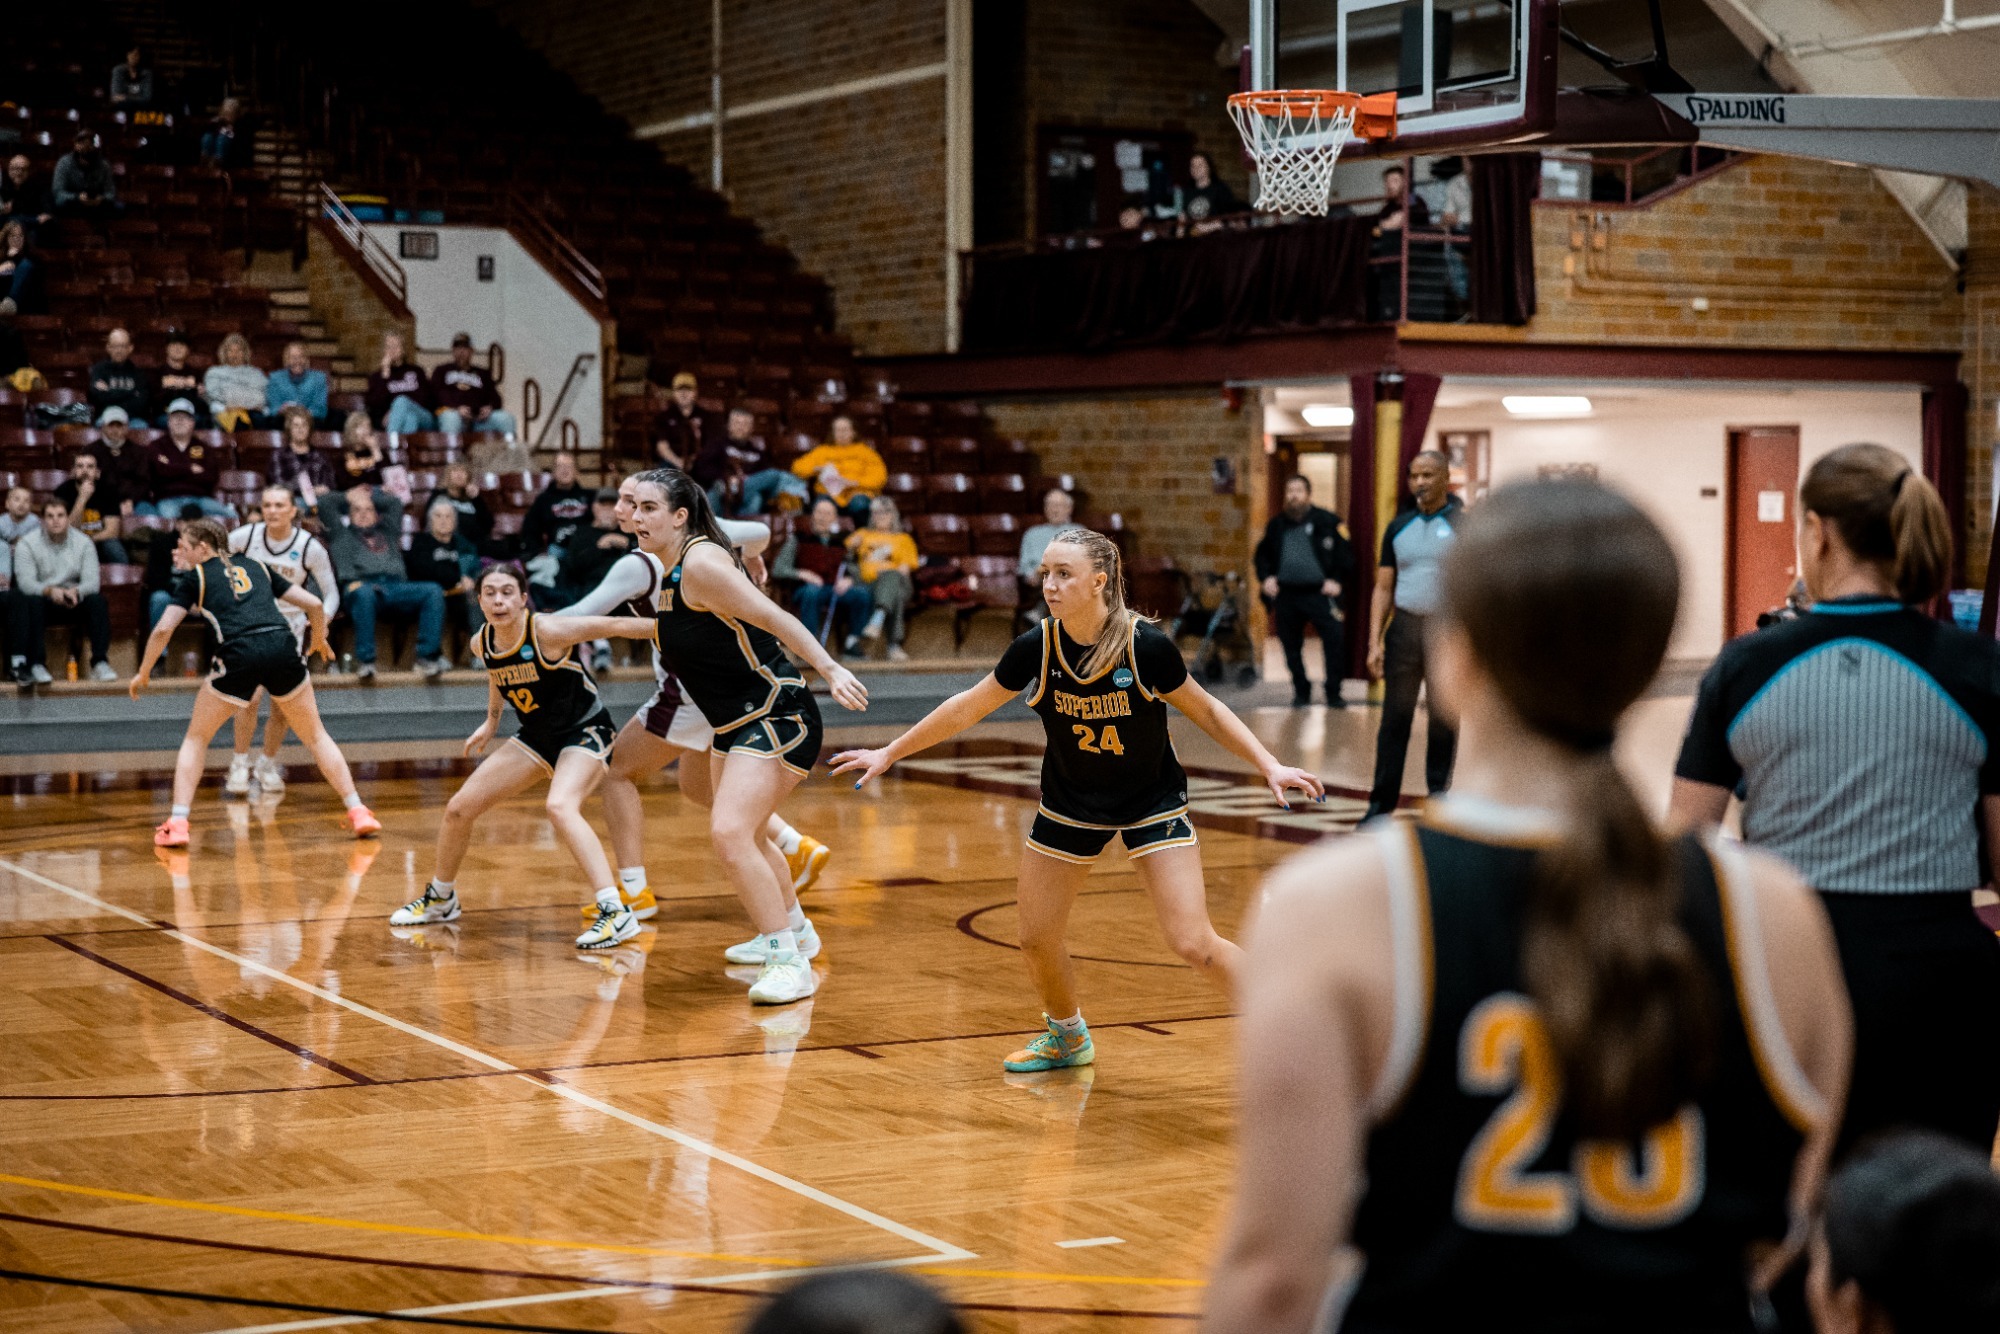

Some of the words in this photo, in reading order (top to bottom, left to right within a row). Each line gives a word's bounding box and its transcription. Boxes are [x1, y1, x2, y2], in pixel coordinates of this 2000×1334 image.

[1686, 96, 1785, 123] SPALDING
[224, 566, 252, 594] 3
[507, 688, 540, 713] 12
[1054, 690, 1132, 720] SUPERIOR
[1072, 724, 1125, 755] 24
